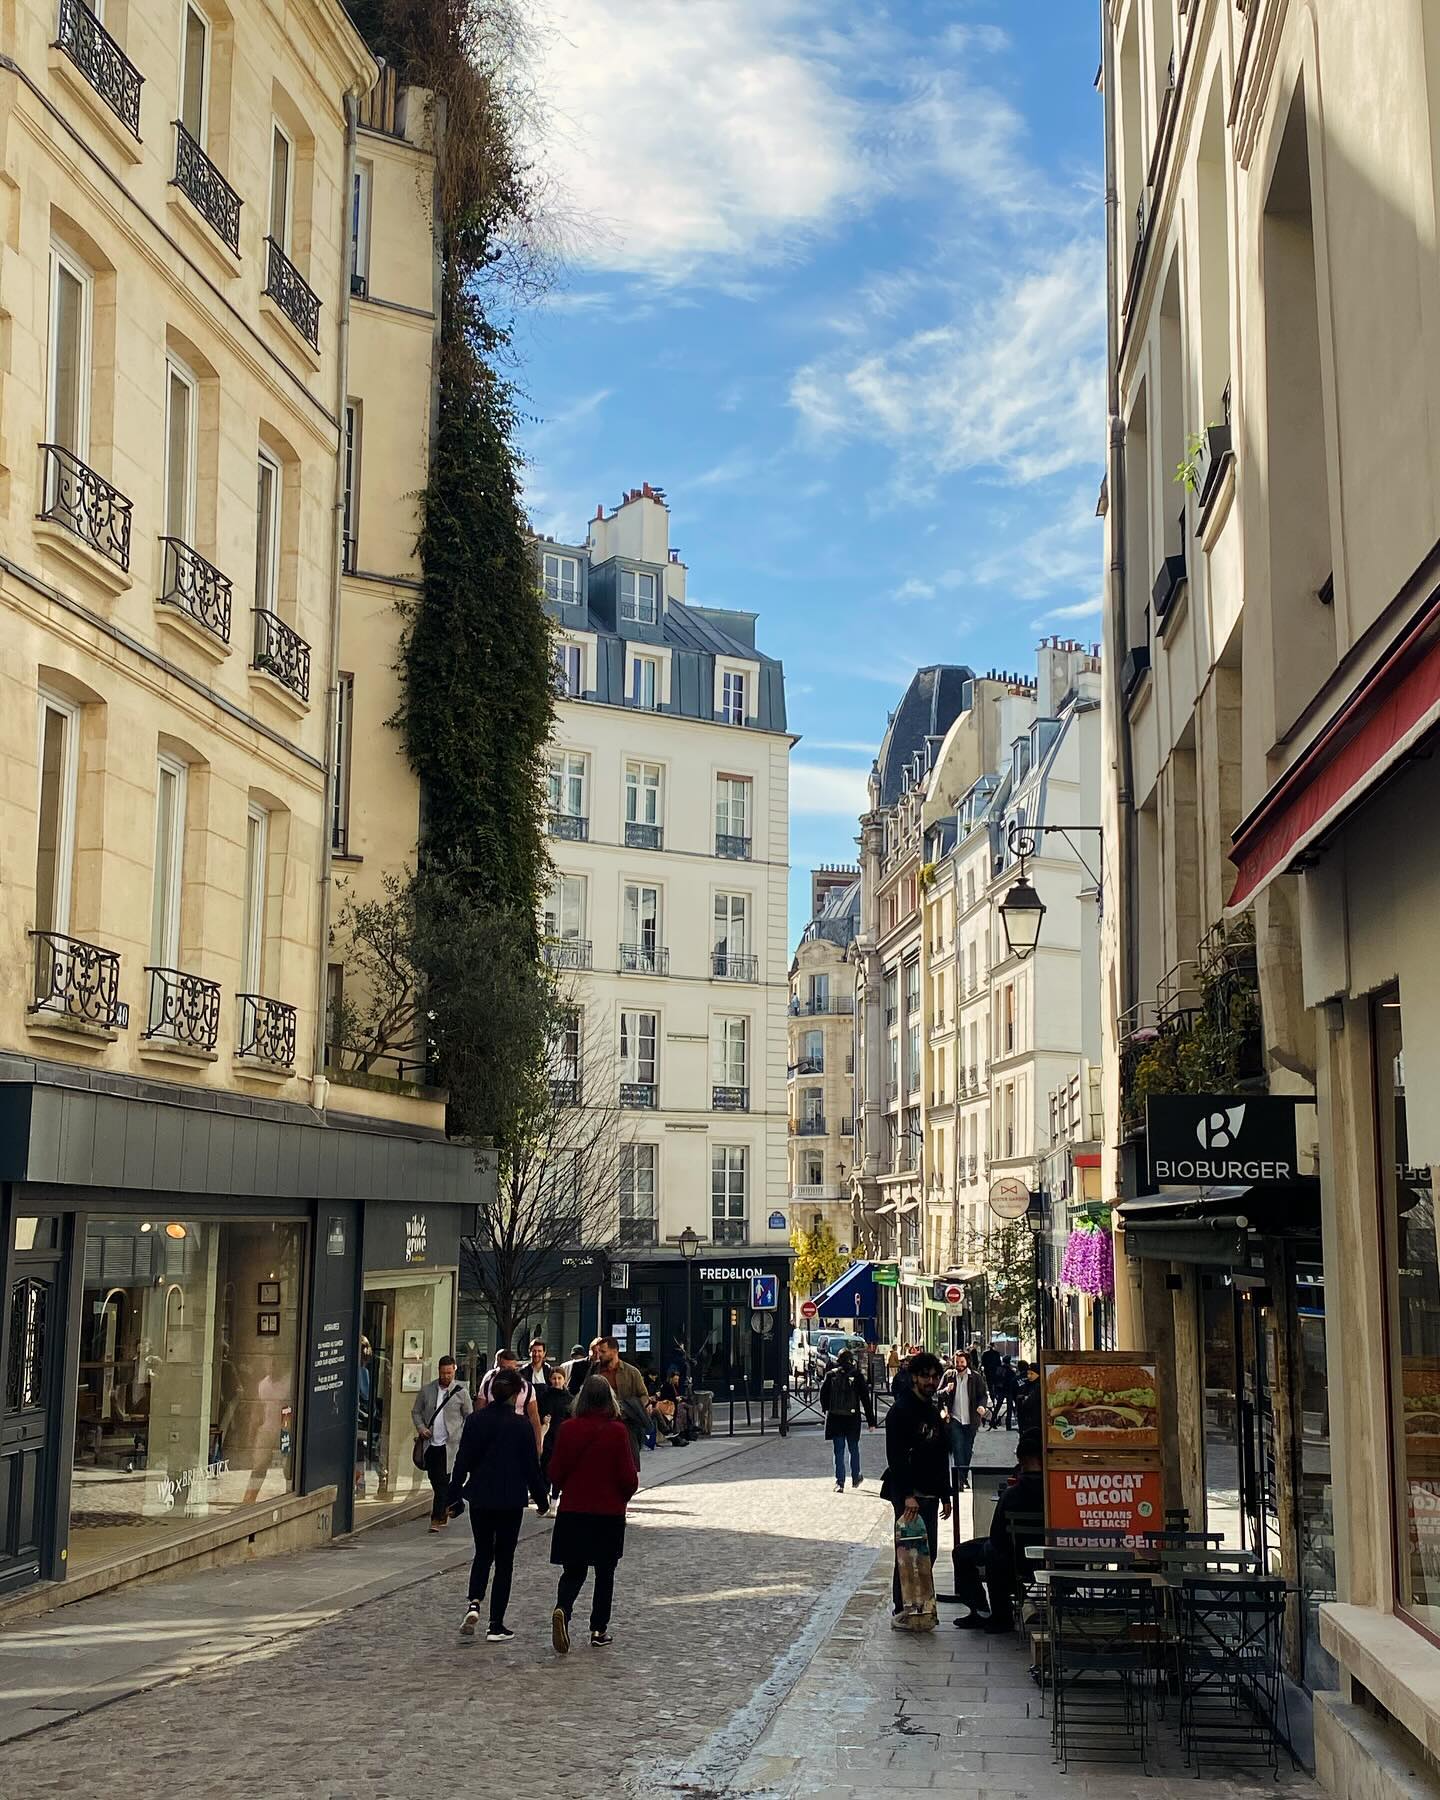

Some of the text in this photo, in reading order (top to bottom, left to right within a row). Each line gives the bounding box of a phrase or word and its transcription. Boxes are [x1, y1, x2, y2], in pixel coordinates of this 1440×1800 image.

[1156, 1160, 1290, 1180] BIOBURGER
[1065, 1474, 1144, 1489] L'AVOCAT
[1075, 1489, 1133, 1506] BACON
[1079, 1510, 1132, 1519] BACK DANS
[1083, 1519, 1130, 1528] LES BACS!
